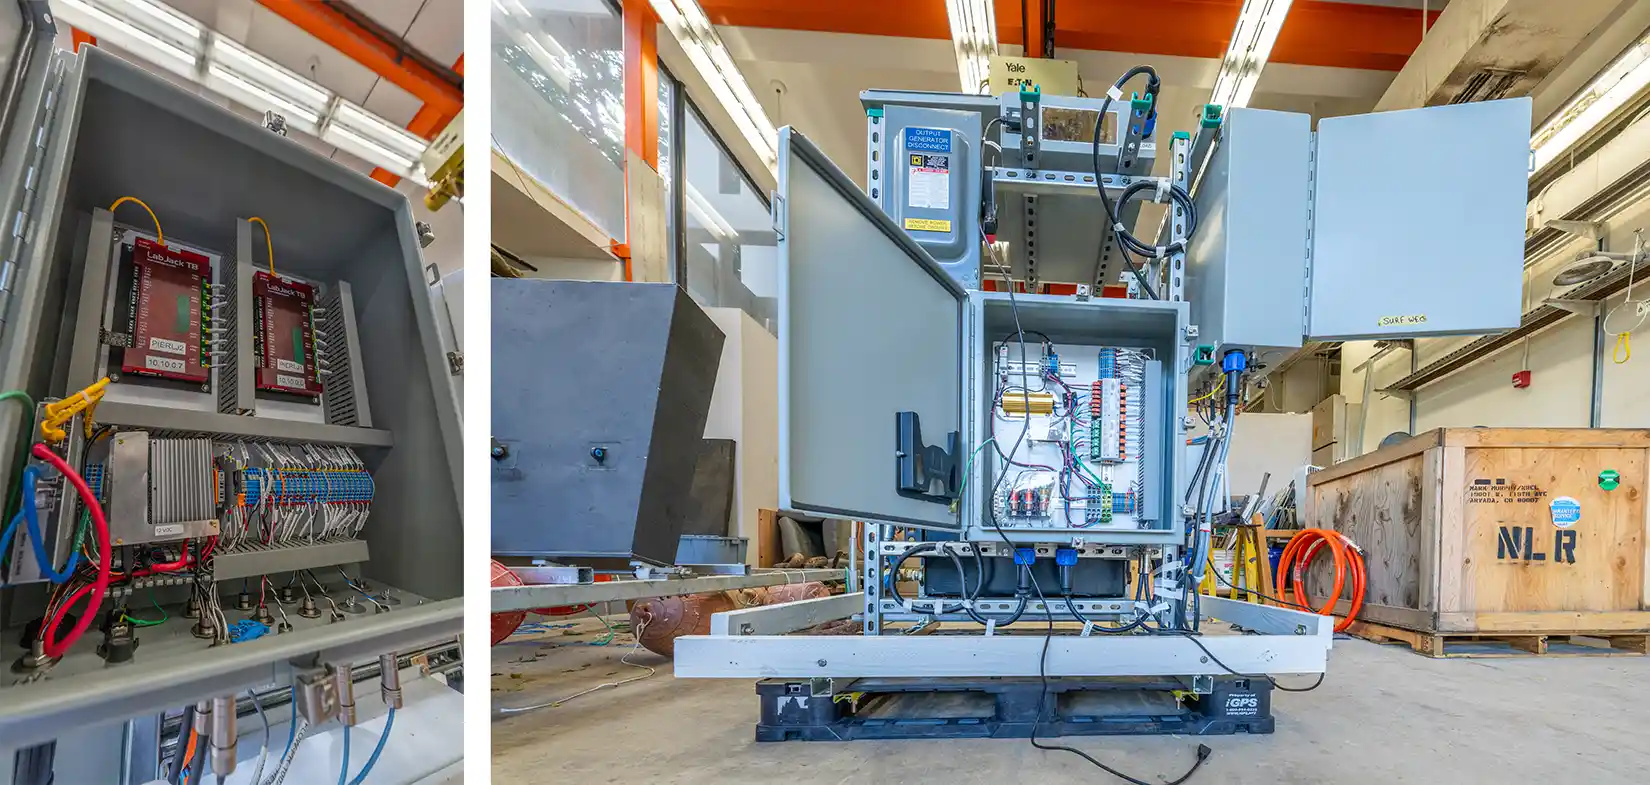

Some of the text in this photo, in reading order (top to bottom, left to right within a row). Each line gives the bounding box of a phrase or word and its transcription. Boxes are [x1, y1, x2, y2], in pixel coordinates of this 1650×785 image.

[1005, 62, 1026, 73] Yale
[915, 129, 941, 137] OUTPUT
[908, 135, 949, 144] GENERATOR
[907, 141, 949, 150] DISCONNECT
[147, 251, 184, 267] LabJack
[267, 283, 296, 296] LabJack
[1383, 315, 1405, 325] SURF
[1225, 698, 1258, 707] iGPS
